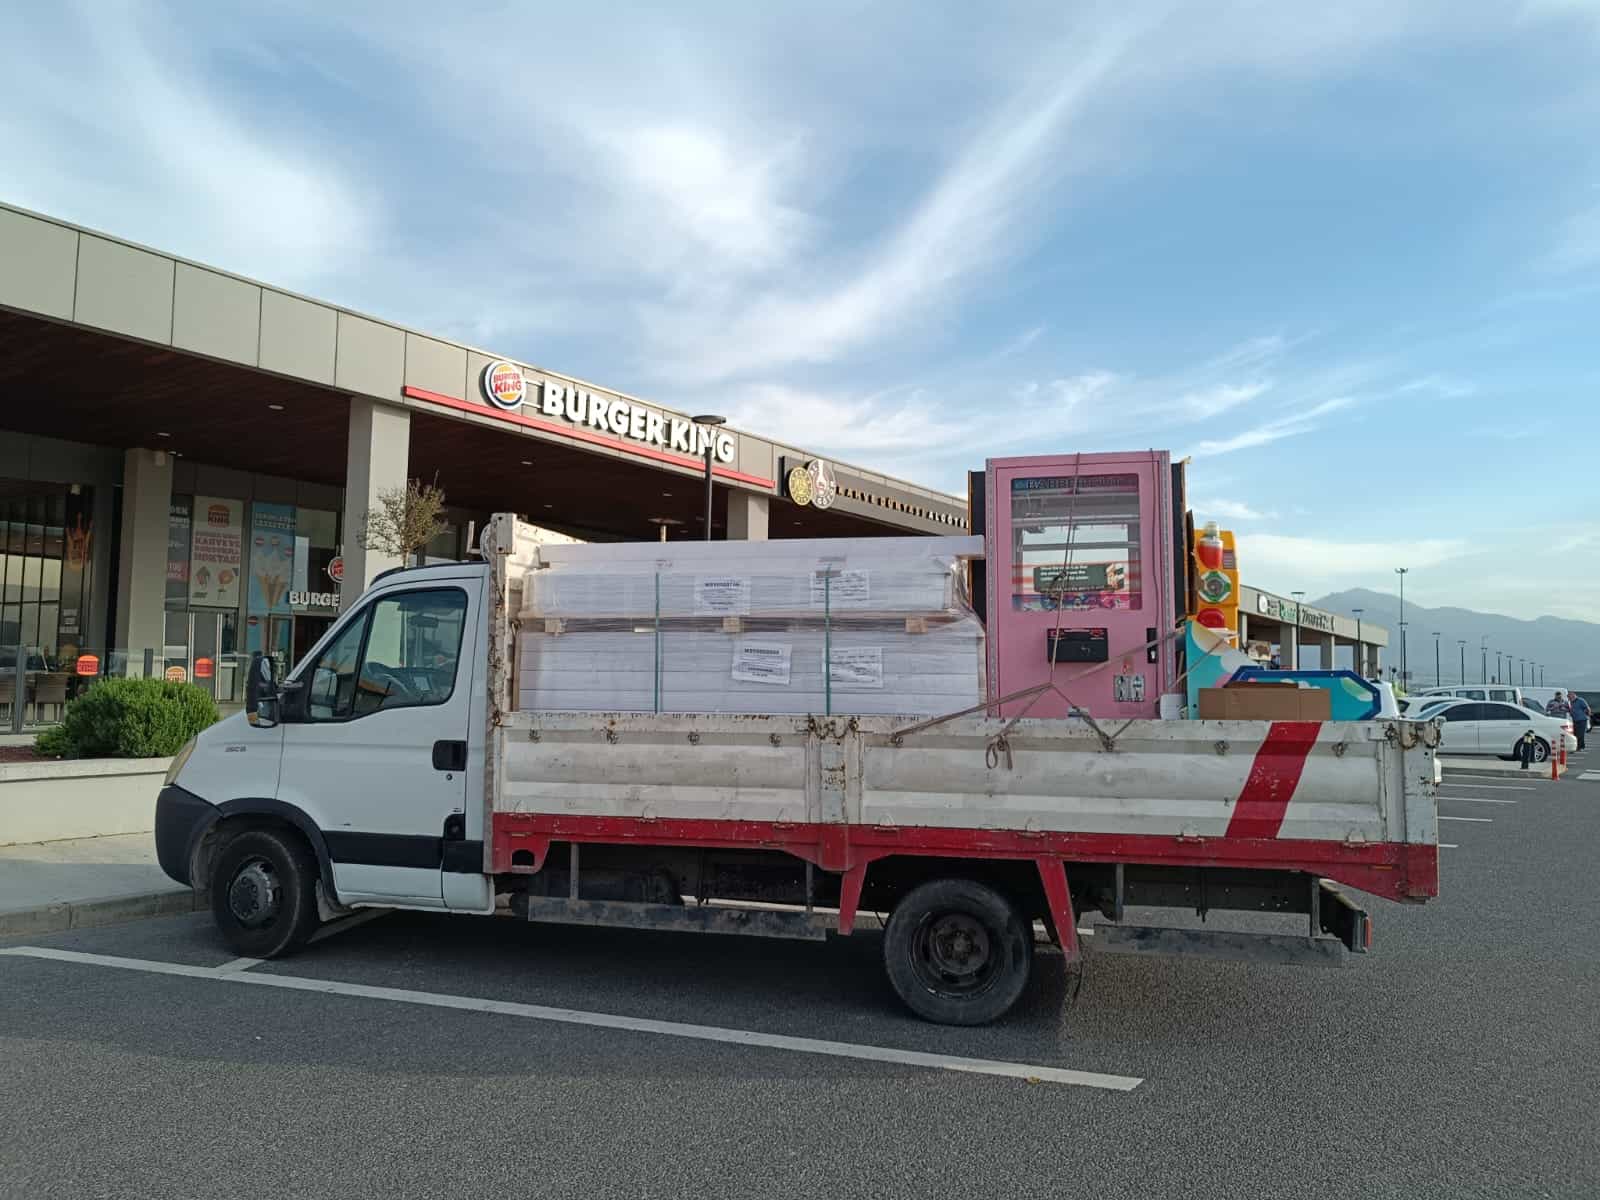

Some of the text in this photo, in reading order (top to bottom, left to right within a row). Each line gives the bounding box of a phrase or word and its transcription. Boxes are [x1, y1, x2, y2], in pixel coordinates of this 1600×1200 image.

[493, 372, 521, 384] BURGER
[494, 381, 522, 394] KING
[543, 379, 735, 463] BURGER KING
